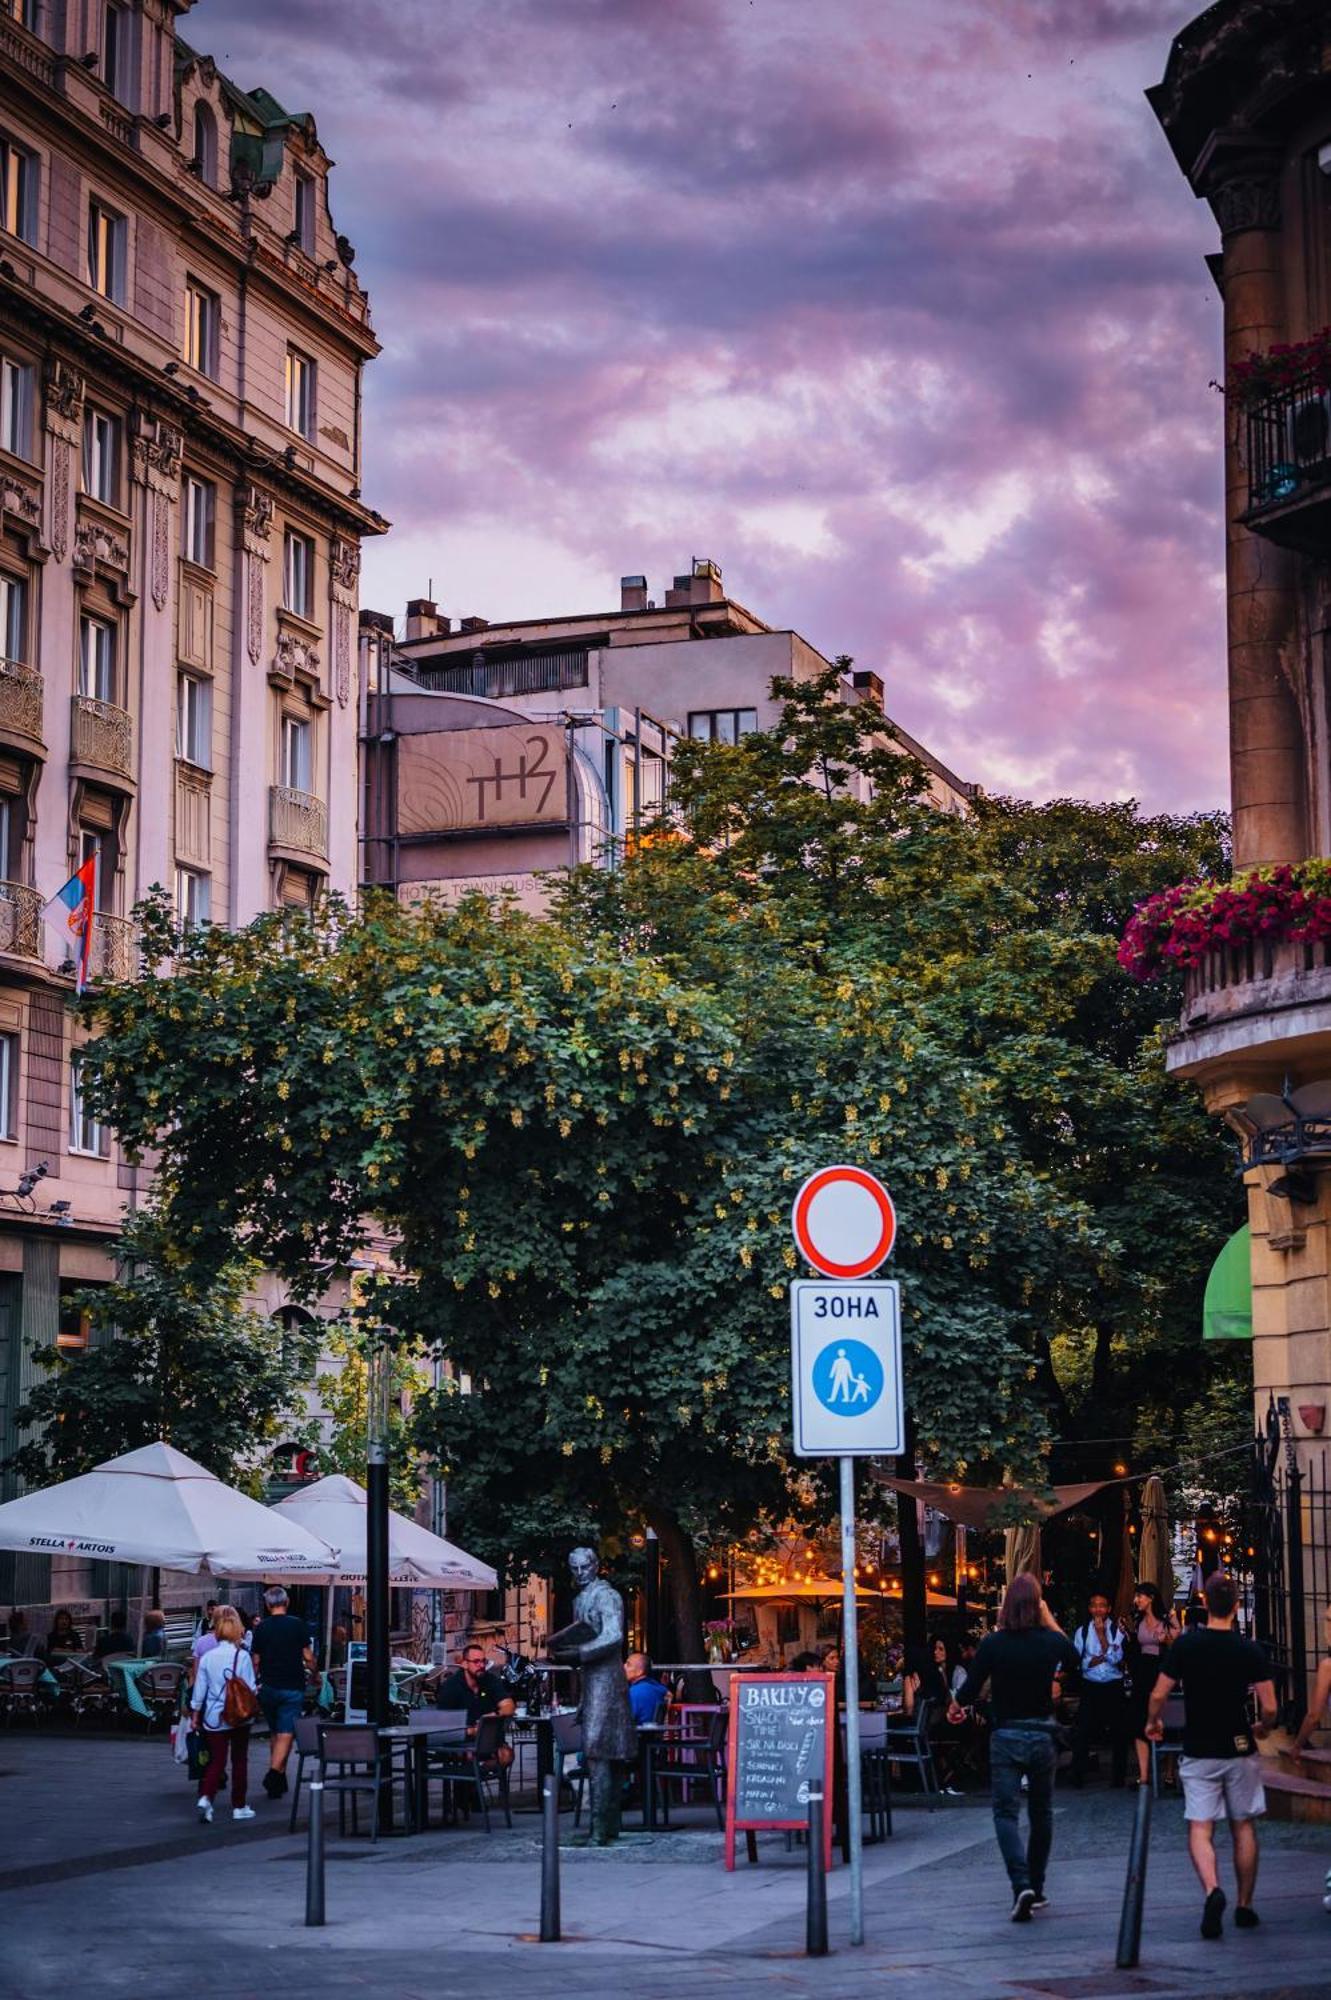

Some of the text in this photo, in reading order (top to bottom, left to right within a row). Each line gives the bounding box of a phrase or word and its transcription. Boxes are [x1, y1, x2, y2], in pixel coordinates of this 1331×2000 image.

[814, 1296, 880, 1319] ЗОНА
[28, 1536, 116, 1554] STELLA ARTOIS
